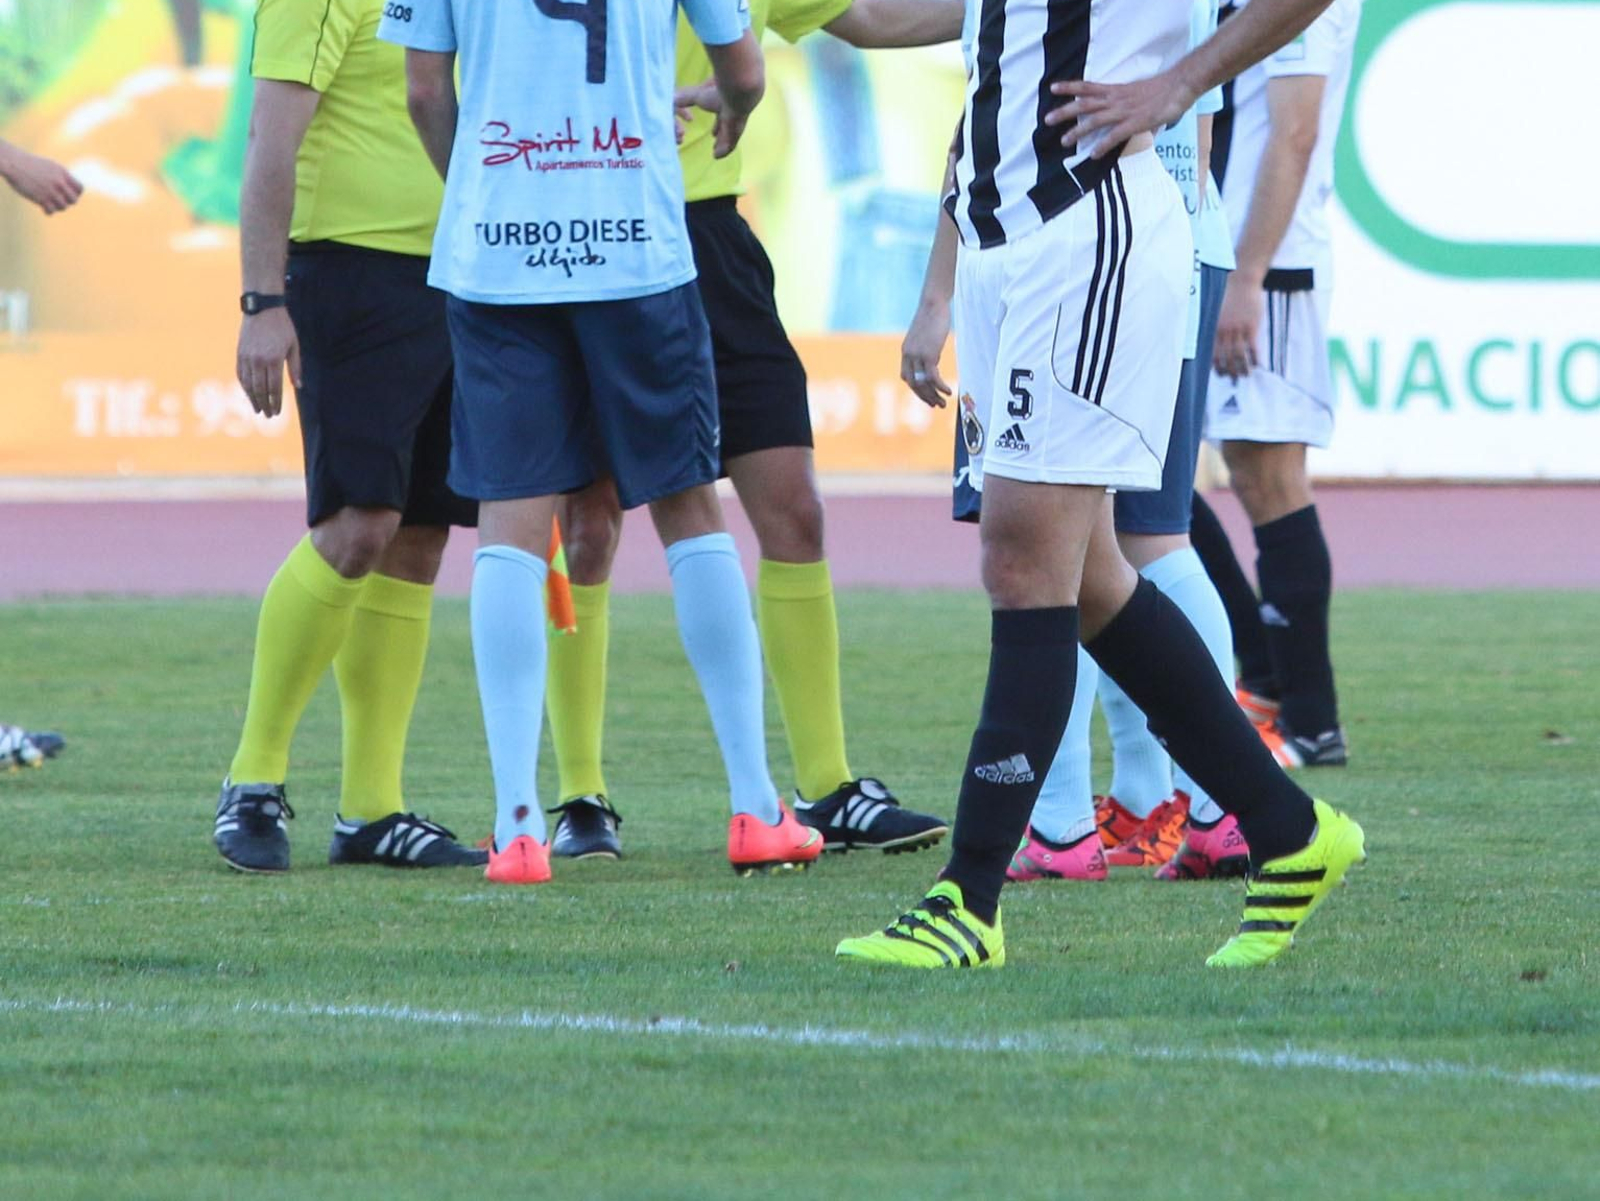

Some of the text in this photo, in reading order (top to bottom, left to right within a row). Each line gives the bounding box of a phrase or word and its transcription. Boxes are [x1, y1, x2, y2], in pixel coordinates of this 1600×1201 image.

[384, 2, 413, 23] ZOS
[480, 116, 580, 171] Spirit
[569, 218, 652, 243] DIESE
[1006, 367, 1034, 421] 5
[1327, 338, 1600, 411] NACIO
[974, 765, 1035, 785] adidas
